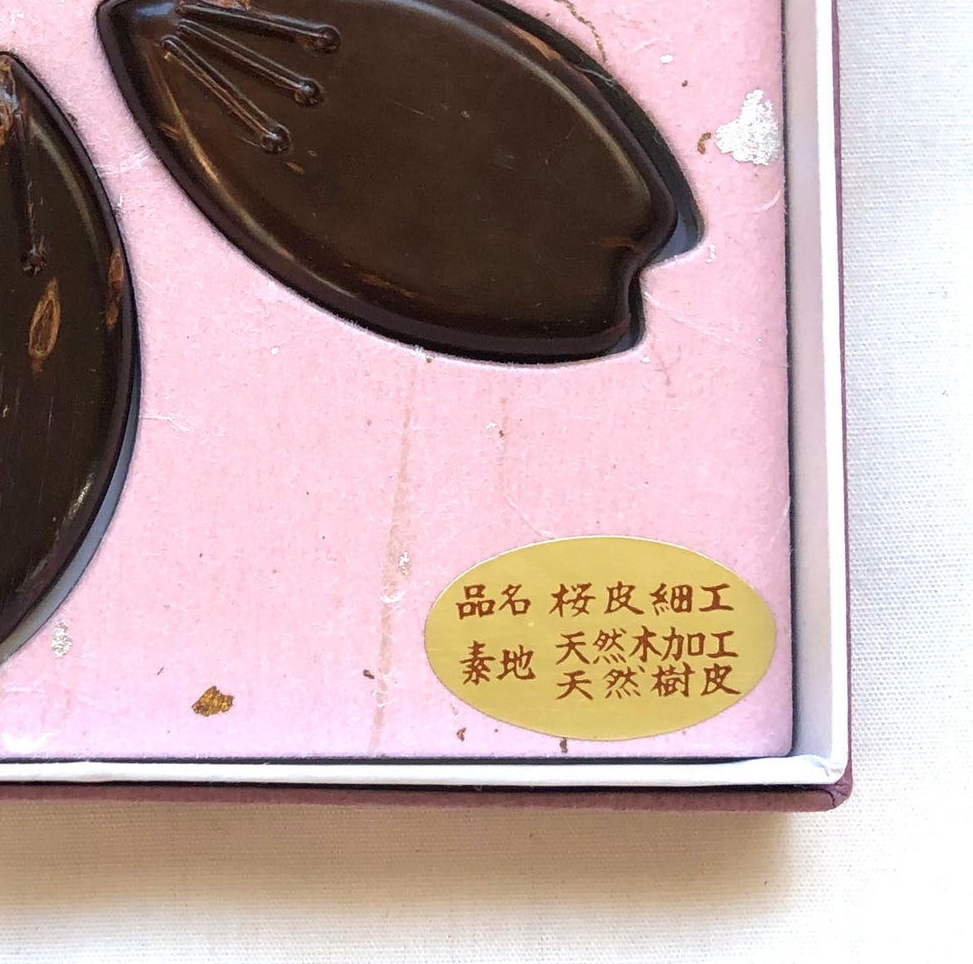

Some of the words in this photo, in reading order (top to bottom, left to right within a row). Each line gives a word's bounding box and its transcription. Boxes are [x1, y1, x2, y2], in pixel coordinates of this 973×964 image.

[455, 582, 533, 620] 品名
[548, 581, 735, 618] 桜皮細工
[459, 639, 537, 686] 素地
[555, 625, 740, 666] 天然木加工
[556, 661, 742, 701] 天然樹皮
